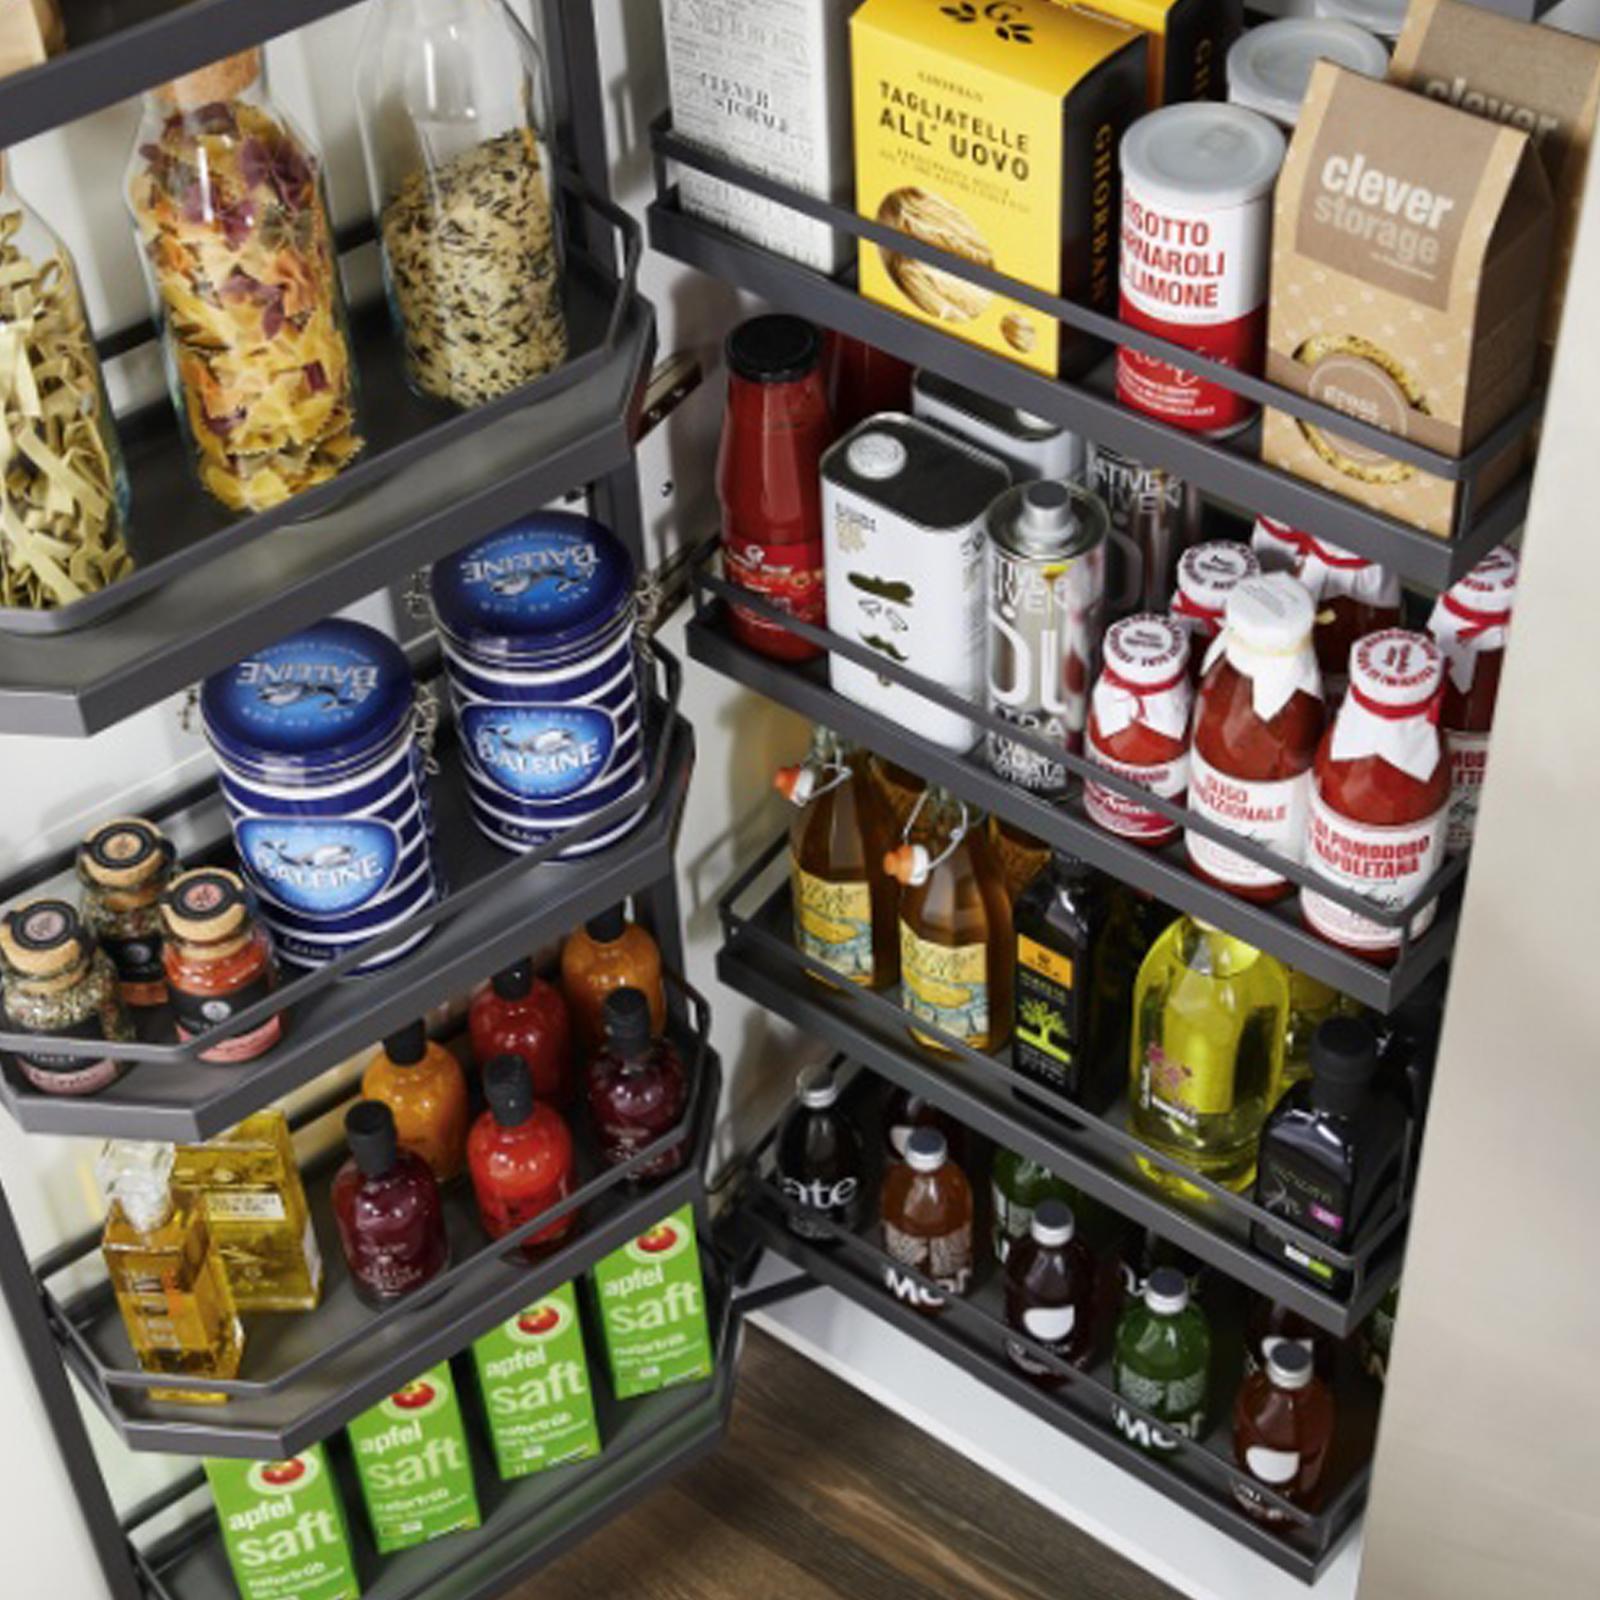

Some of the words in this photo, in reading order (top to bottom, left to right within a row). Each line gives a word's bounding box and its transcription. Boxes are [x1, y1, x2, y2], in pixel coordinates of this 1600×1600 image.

[880, 80, 1029, 154] TAGLIATELLE
[950, 134, 1030, 182] UOVO
[1321, 153, 1454, 230] clever
[1313, 195, 1440, 266] storage
[460, 544, 600, 584] BALEINE
[235, 661, 380, 689] BALEINE
[476, 734, 602, 774] BALEINE
[1331, 829, 1430, 860] POMODORO
[254, 850, 386, 888] BALEINE
[604, 1263, 664, 1298] apfel
[609, 1280, 699, 1334] saft
[486, 1344, 547, 1378] apfel
[491, 1360, 587, 1415] saft
[361, 1419, 422, 1455] apfel
[366, 1437, 464, 1489] saft
[229, 1494, 295, 1531] apfel
[237, 1509, 340, 1568] saft
